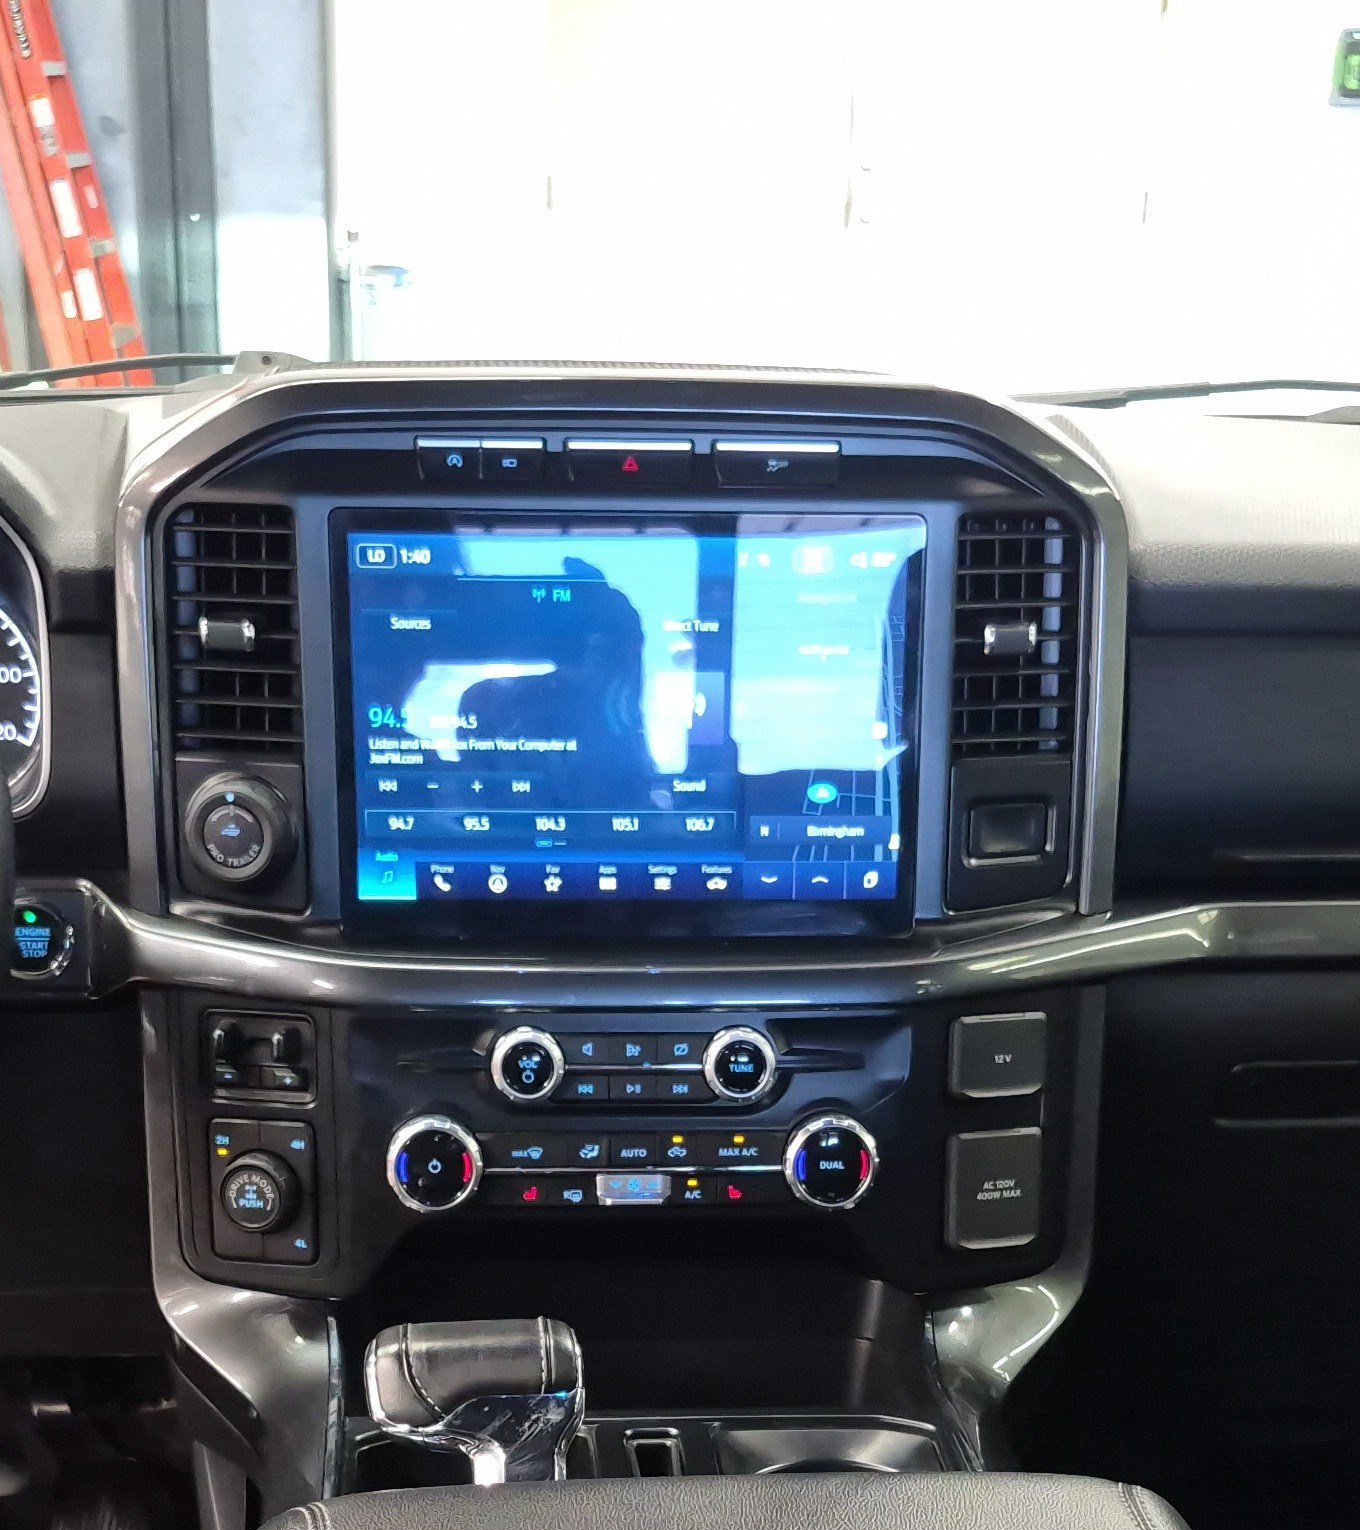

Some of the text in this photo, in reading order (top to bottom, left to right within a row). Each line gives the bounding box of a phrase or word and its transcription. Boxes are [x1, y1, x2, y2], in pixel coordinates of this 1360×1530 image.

[400, 548, 431, 564] 1:40
[552, 589, 572, 602] FM
[390, 615, 431, 630] Sources
[693, 619, 719, 632] Tune
[517, 738, 565, 752] Computer
[673, 779, 707, 793] Sound
[388, 815, 415, 831] 94.7
[463, 815, 490, 831] 95.5
[535, 816, 566, 831] 104.3
[612, 817, 639, 832] 105.1
[807, 825, 865, 839] Birmingham
[207, 843, 260, 868] PRO TRAILER
[14, 926, 51, 937] ENGINE
[19, 941, 49, 950] START
[21, 949, 48, 959] STOP
[518, 1059, 538, 1070] VOL
[729, 1063, 754, 1073] TUNE
[215, 1135, 230, 1145] 2H
[620, 1149, 647, 1158] AUTO
[718, 1147, 758, 1157] MAX A/C
[819, 1160, 844, 1170] DUAL
[229, 1173, 275, 1200] DRIVE MODE
[684, 1190, 703, 1199] A/C
[1003, 1189, 1022, 1199] MAX
[239, 1198, 264, 1209] PUSH
